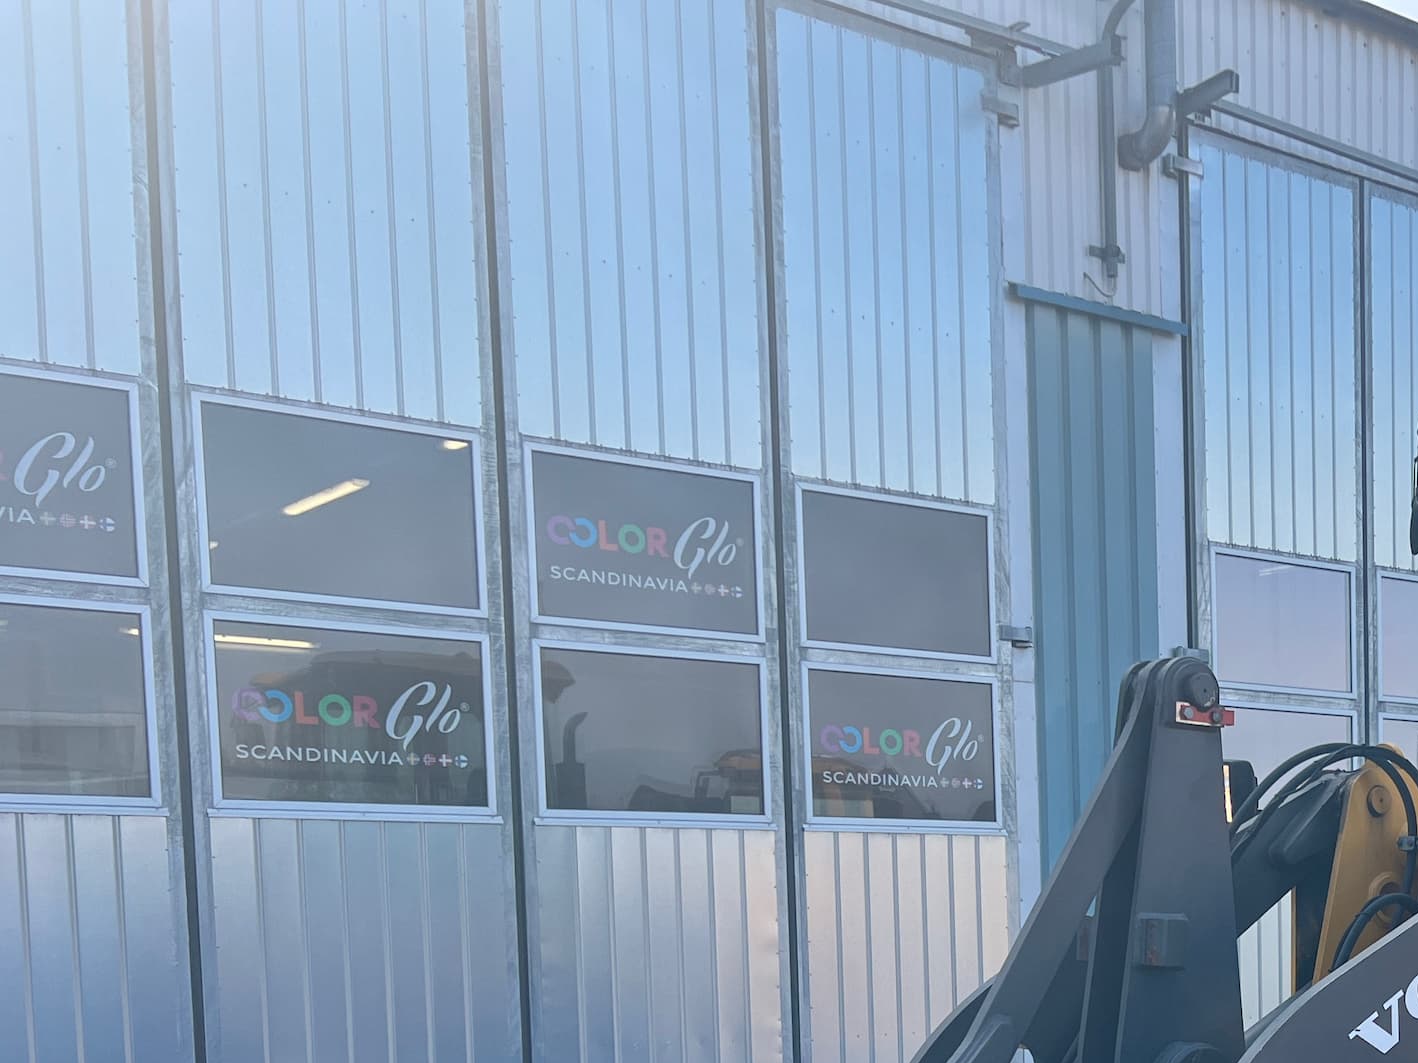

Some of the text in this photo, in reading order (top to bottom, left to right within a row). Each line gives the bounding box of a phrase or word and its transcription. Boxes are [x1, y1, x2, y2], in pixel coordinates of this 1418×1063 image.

[14, 431, 106, 508] Glo
[546, 515, 737, 580] COLOR Glo
[550, 565, 689, 593] SCANDINAVIA
[231, 680, 461, 752] COLOR Glo
[235, 743, 404, 766] SCANDINAVIA
[820, 717, 979, 775] COLOR Glo
[822, 770, 938, 789] SCANDINAVIA
